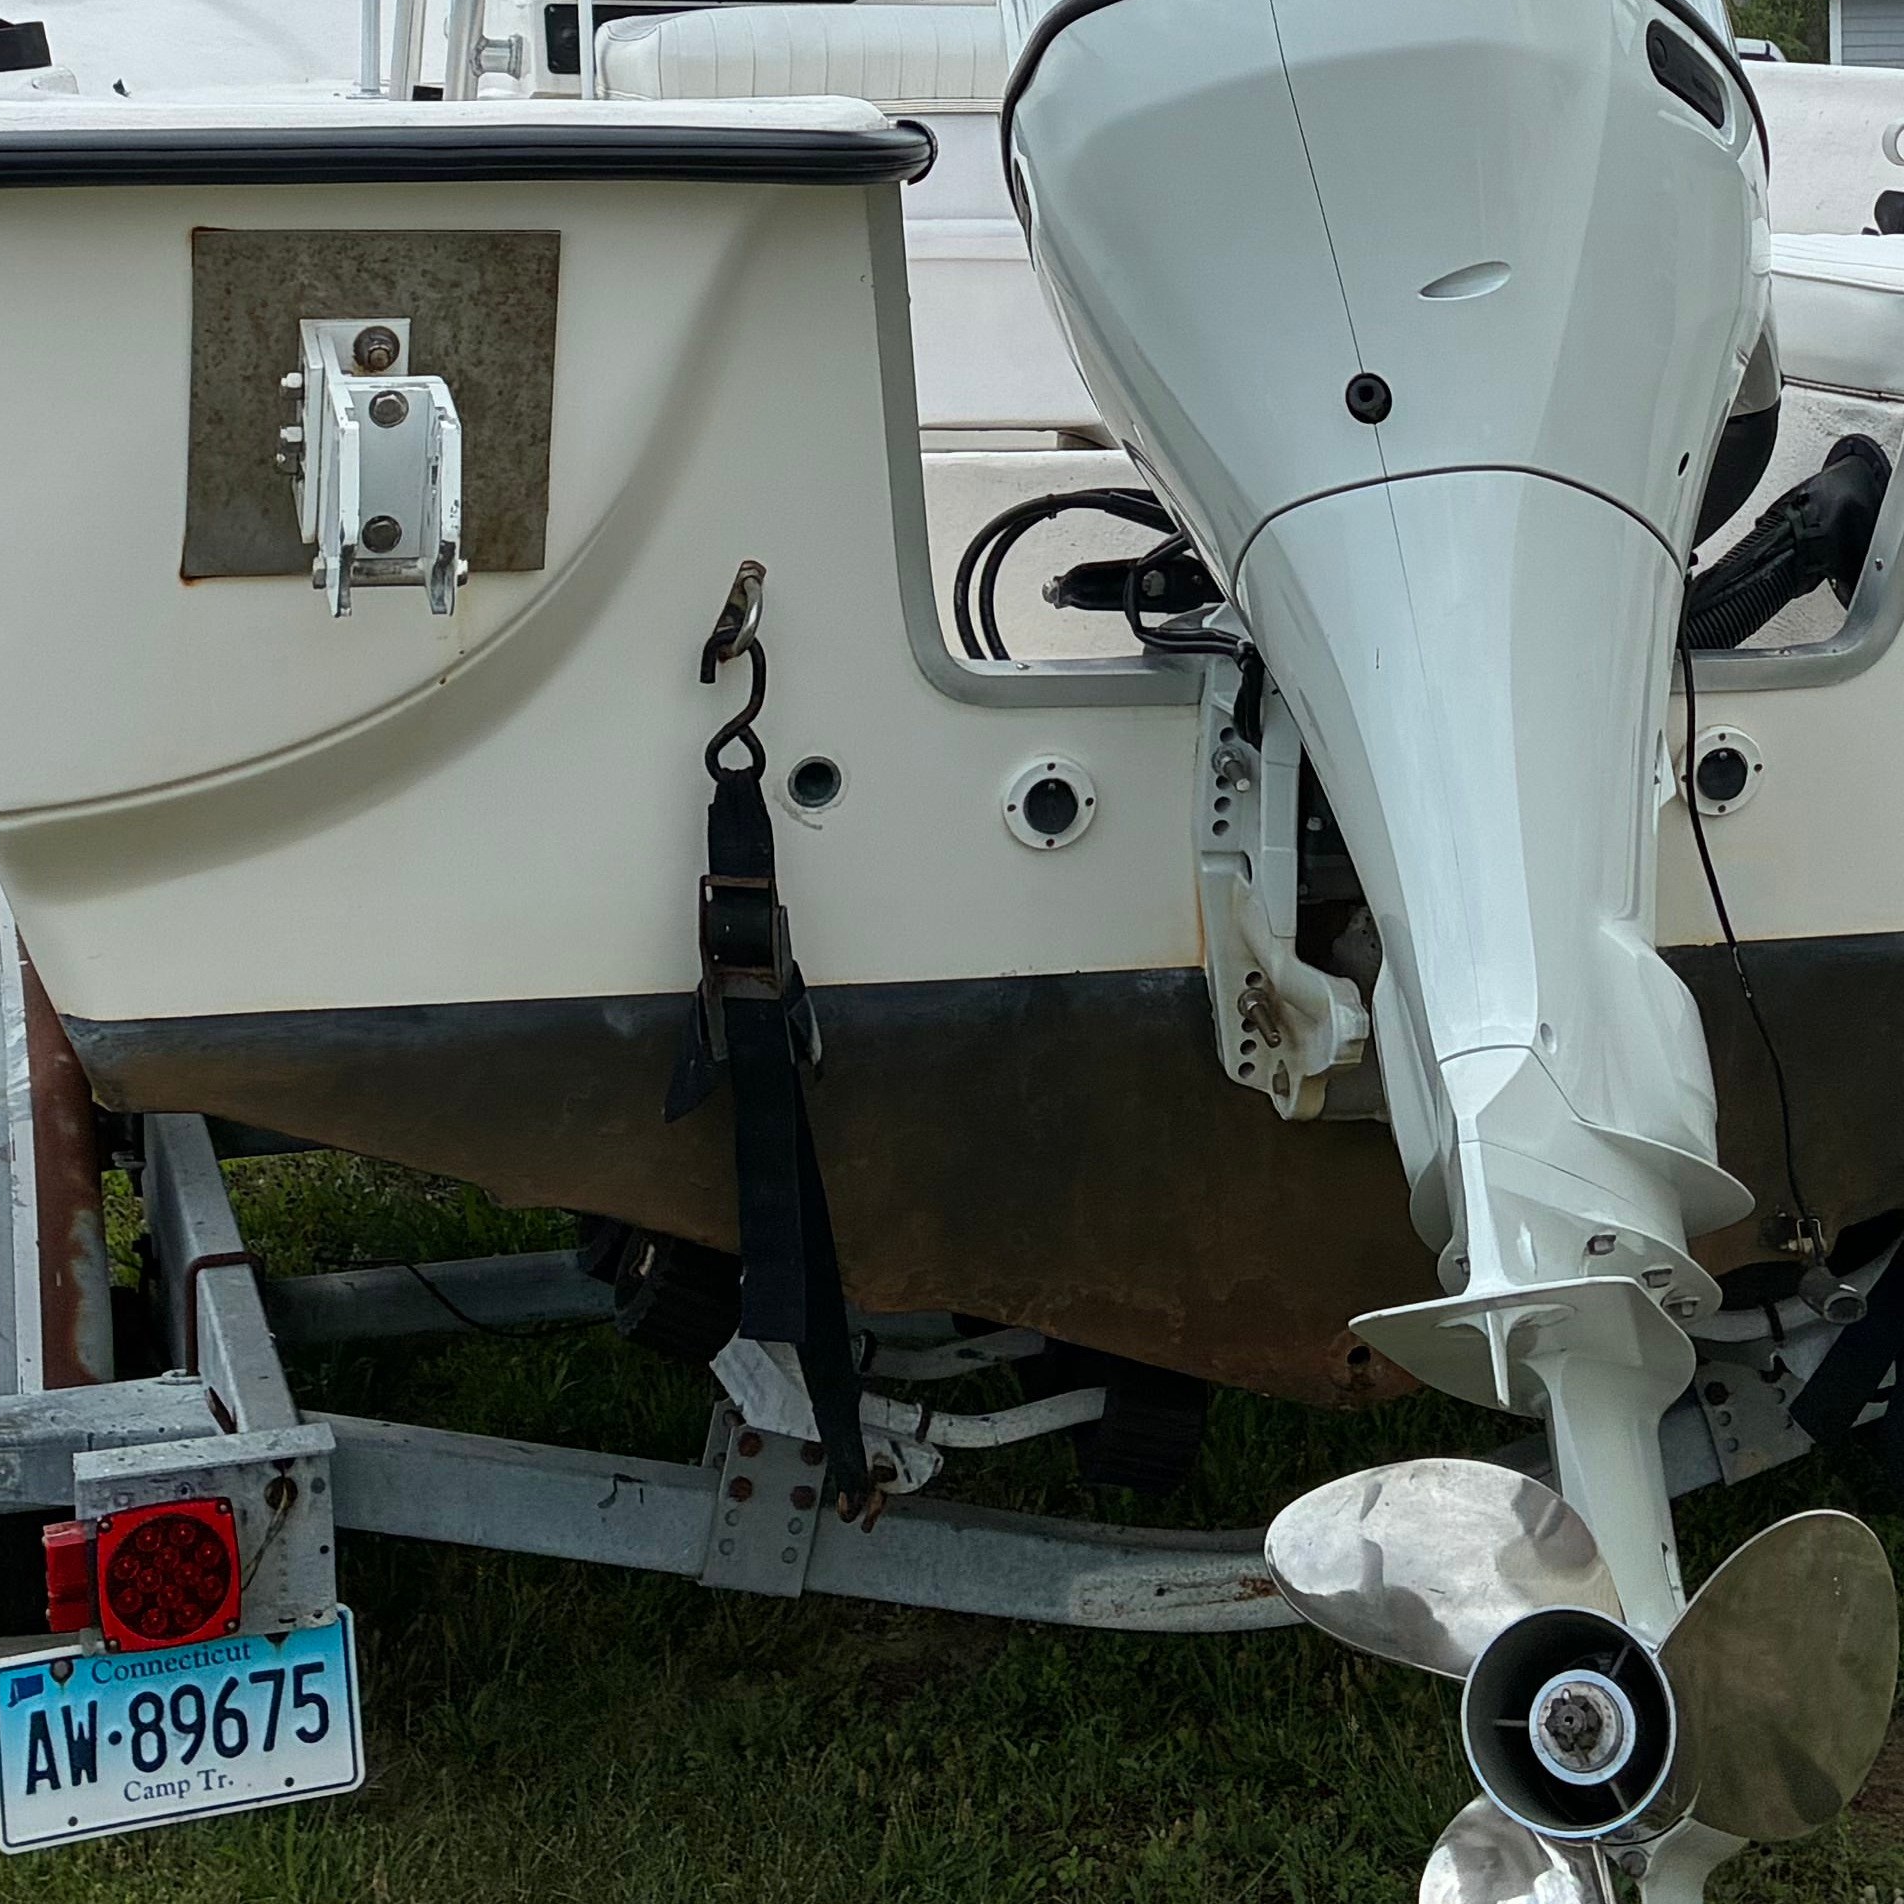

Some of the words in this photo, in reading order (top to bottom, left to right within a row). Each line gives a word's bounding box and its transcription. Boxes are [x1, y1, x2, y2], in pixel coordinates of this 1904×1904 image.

[92, 1642, 251, 1684] Connecticut
[123, 1779, 191, 1802] Camp
[197, 1768, 234, 1791] Tr.
